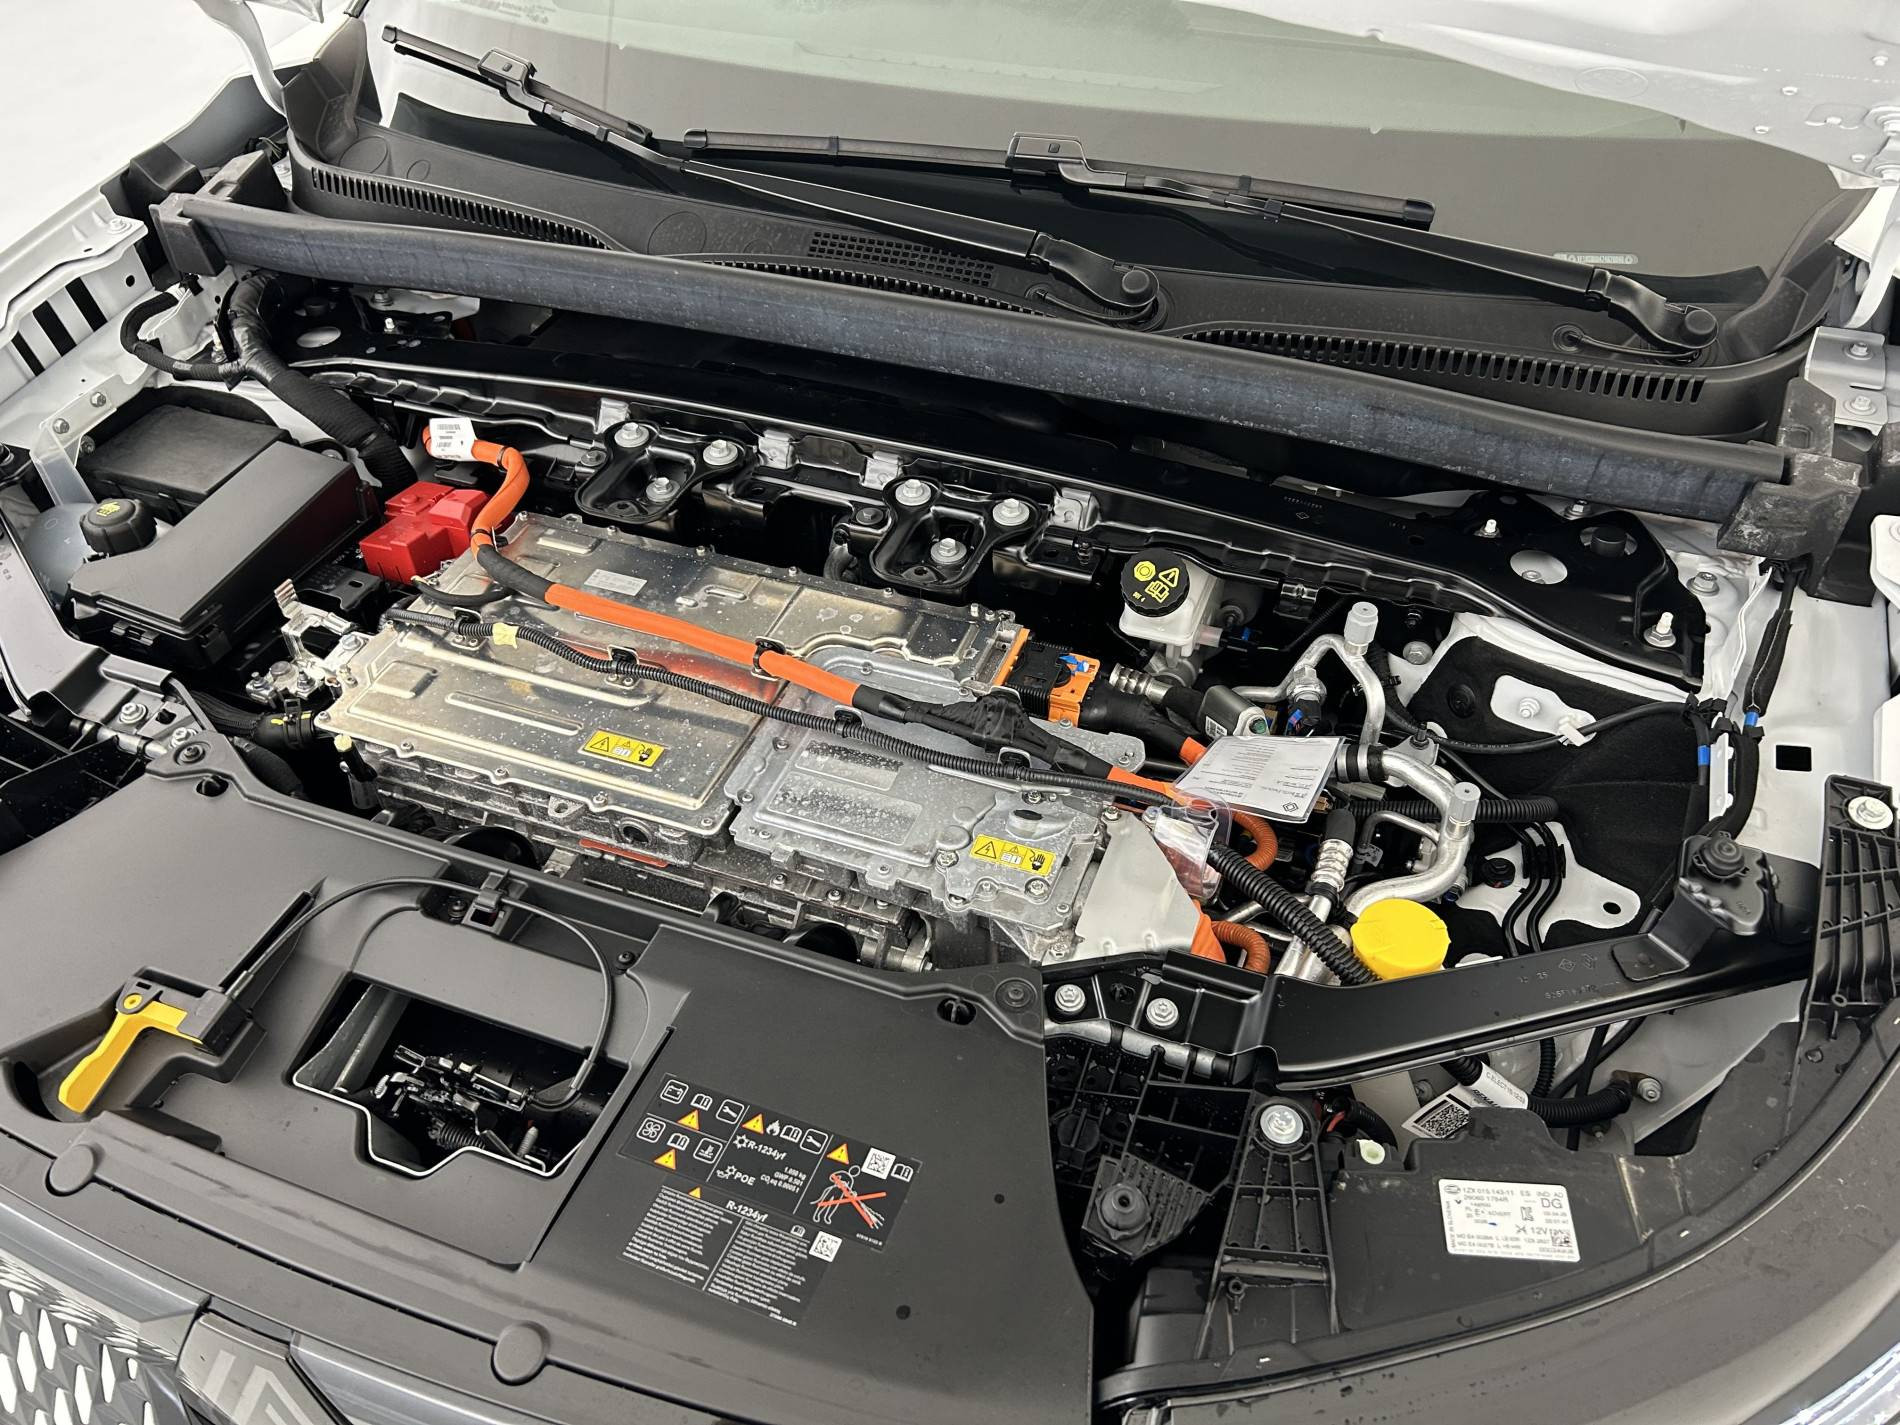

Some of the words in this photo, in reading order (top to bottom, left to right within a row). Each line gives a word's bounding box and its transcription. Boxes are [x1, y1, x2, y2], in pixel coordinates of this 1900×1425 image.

[747, 1140, 787, 1160] R-1234yf
[734, 1171, 756, 1186] POE
[726, 1200, 768, 1222] R-1234yf
[1540, 1197, 1563, 1209] DG
